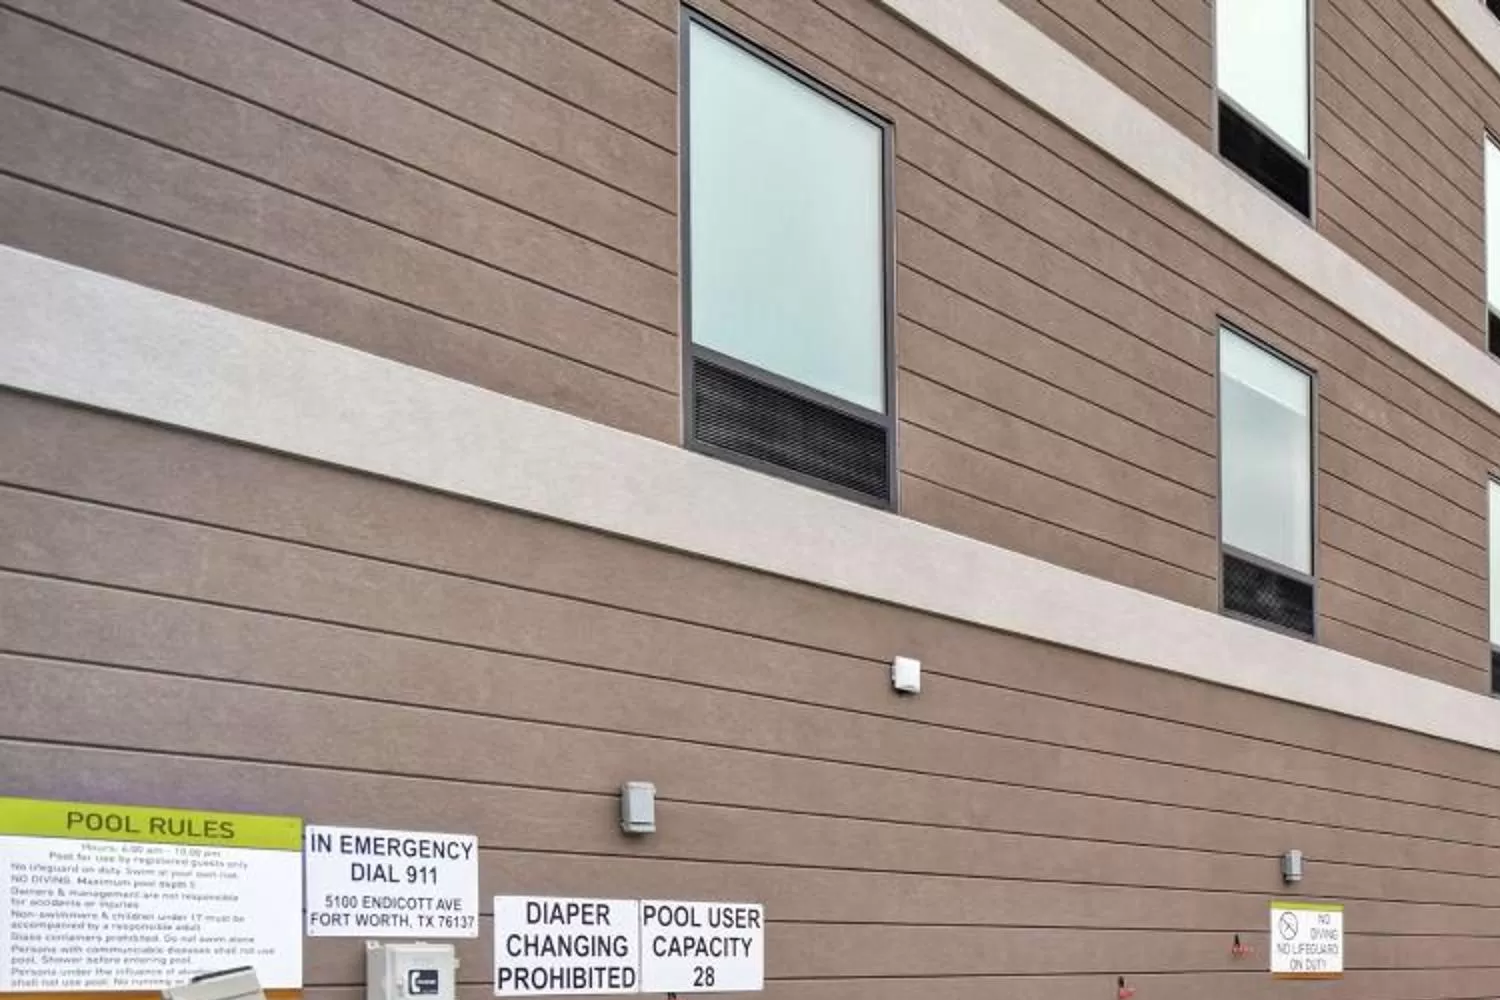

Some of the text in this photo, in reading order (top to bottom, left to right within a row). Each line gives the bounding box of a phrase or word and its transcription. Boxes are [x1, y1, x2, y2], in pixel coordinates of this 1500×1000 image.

[66, 811, 236, 840] POOL RULES
[311, 833, 473, 860] IN EMERGENCY
[351, 862, 437, 885] DIAL 911
[362, 896, 433, 911] ENDICOTT
[435, 898, 462, 911] AVE
[526, 901, 610, 926] DIAPER
[310, 912, 475, 929] FORT WORTH, TX 76137
[643, 905, 761, 929] POOL USER
[506, 933, 629, 957] CHANGING
[653, 935, 753, 958] CAPACITY
[498, 966, 637, 990] PROHIBITED
[693, 966, 715, 987] 28
